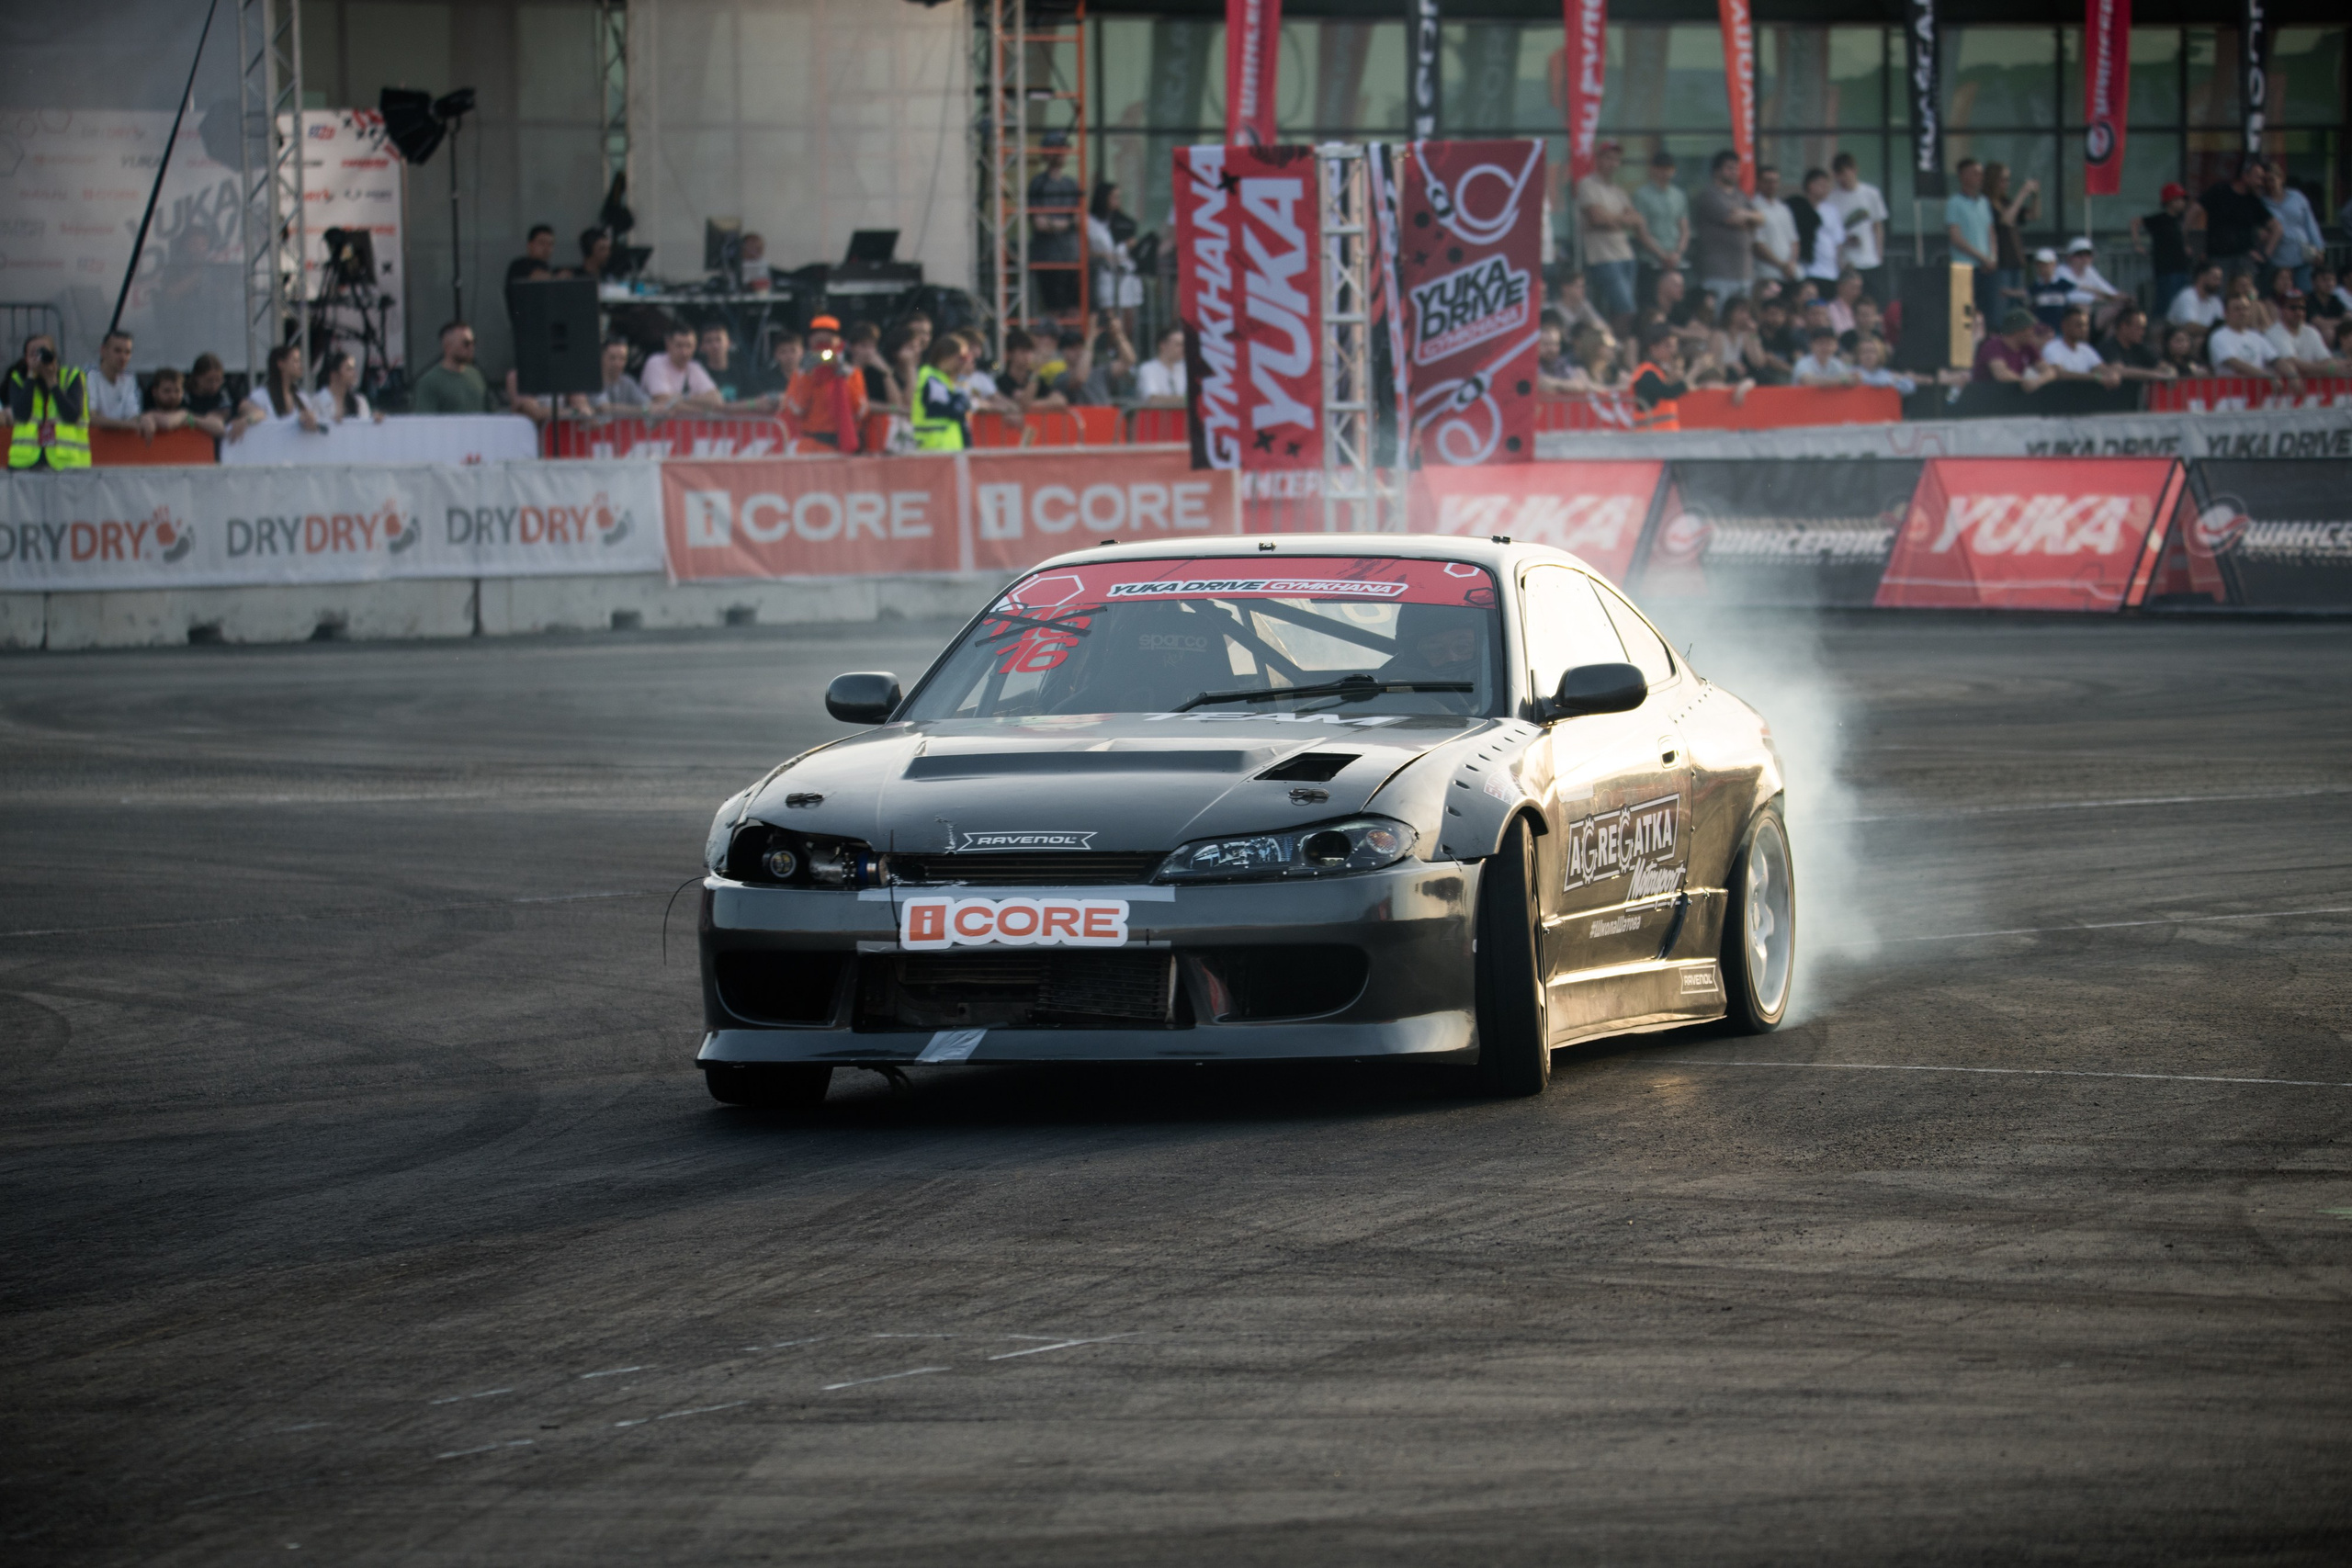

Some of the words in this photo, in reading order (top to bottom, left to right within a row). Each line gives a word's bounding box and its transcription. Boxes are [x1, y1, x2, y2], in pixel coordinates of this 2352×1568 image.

[1190, 145, 1240, 469] GYMKHANA
[1240, 177, 1315, 430] YUKA
[1416, 259, 1508, 313] YUKA
[1421, 276, 1525, 342] DRIVE
[2207, 432, 2273, 457] YUKA
[227, 513, 379, 558] DRYDRY
[447, 505, 591, 544] DRYDRY
[1438, 494, 1633, 550] YUKA
[1932, 494, 2130, 555] YUKA
[1112, 582, 1179, 595] YUKA
[1182, 581, 1264, 592] DRIVE
[1270, 581, 1392, 593] GYMKHANA
[995, 637, 1080, 674] 16
[1139, 634, 1208, 650] sparco
[1143, 712, 1413, 726] TEAM
[977, 836, 1078, 845] RAVENOL
[1570, 807, 1673, 885] AGREGATKA
[1625, 857, 1687, 909] Motorsport
[1683, 974, 1713, 986] RAVENOL
